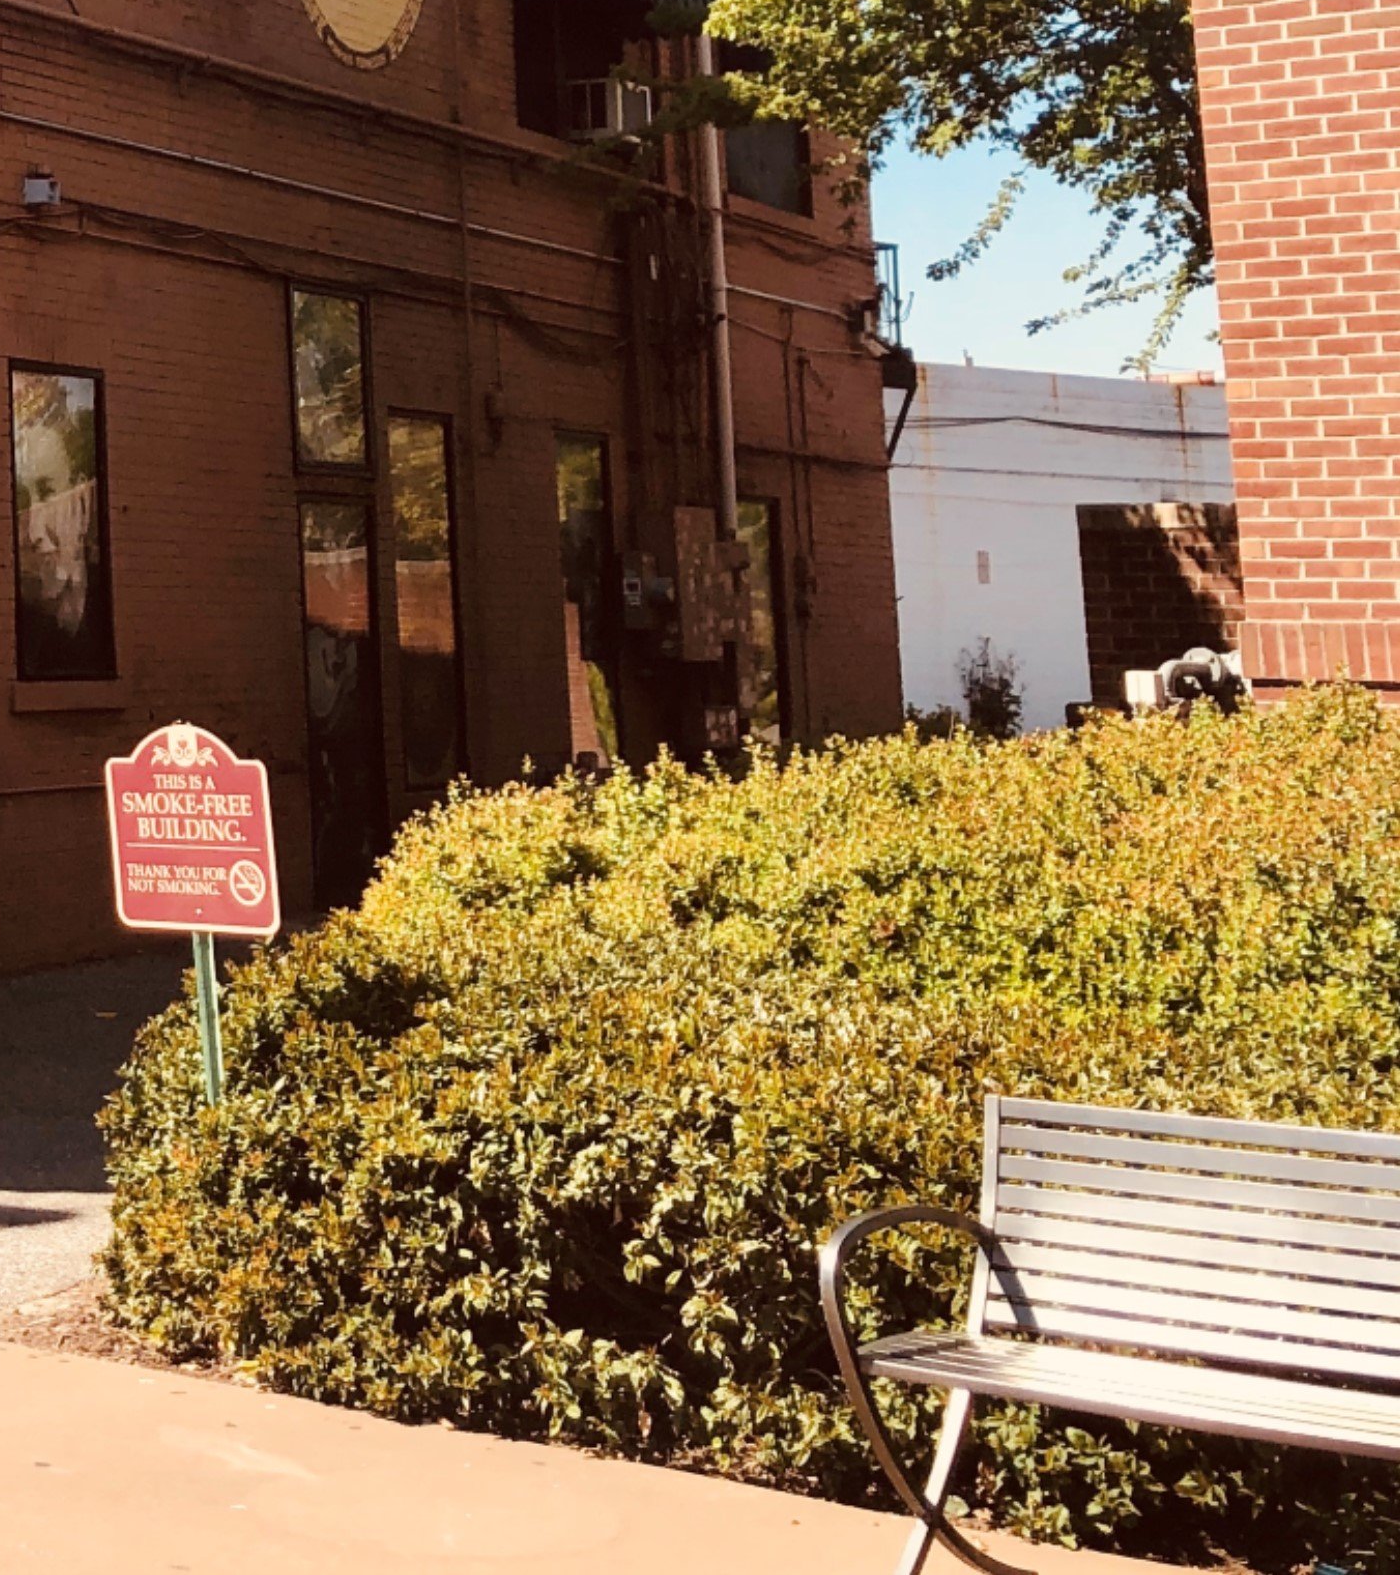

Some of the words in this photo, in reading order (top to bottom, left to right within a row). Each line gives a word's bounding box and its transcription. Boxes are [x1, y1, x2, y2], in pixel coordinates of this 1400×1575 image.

[153, 774, 187, 790] THIS
[189, 775, 202, 790] IS
[204, 775, 216, 791] A
[121, 792, 253, 817] SMOKE-FREE
[137, 817, 247, 842] BUILDING.
[126, 863, 171, 879] THANK
[172, 865, 201, 880] YOU
[202, 866, 227, 882] FOR
[128, 880, 155, 893] NOT
[157, 880, 222, 896] SMOKING.
